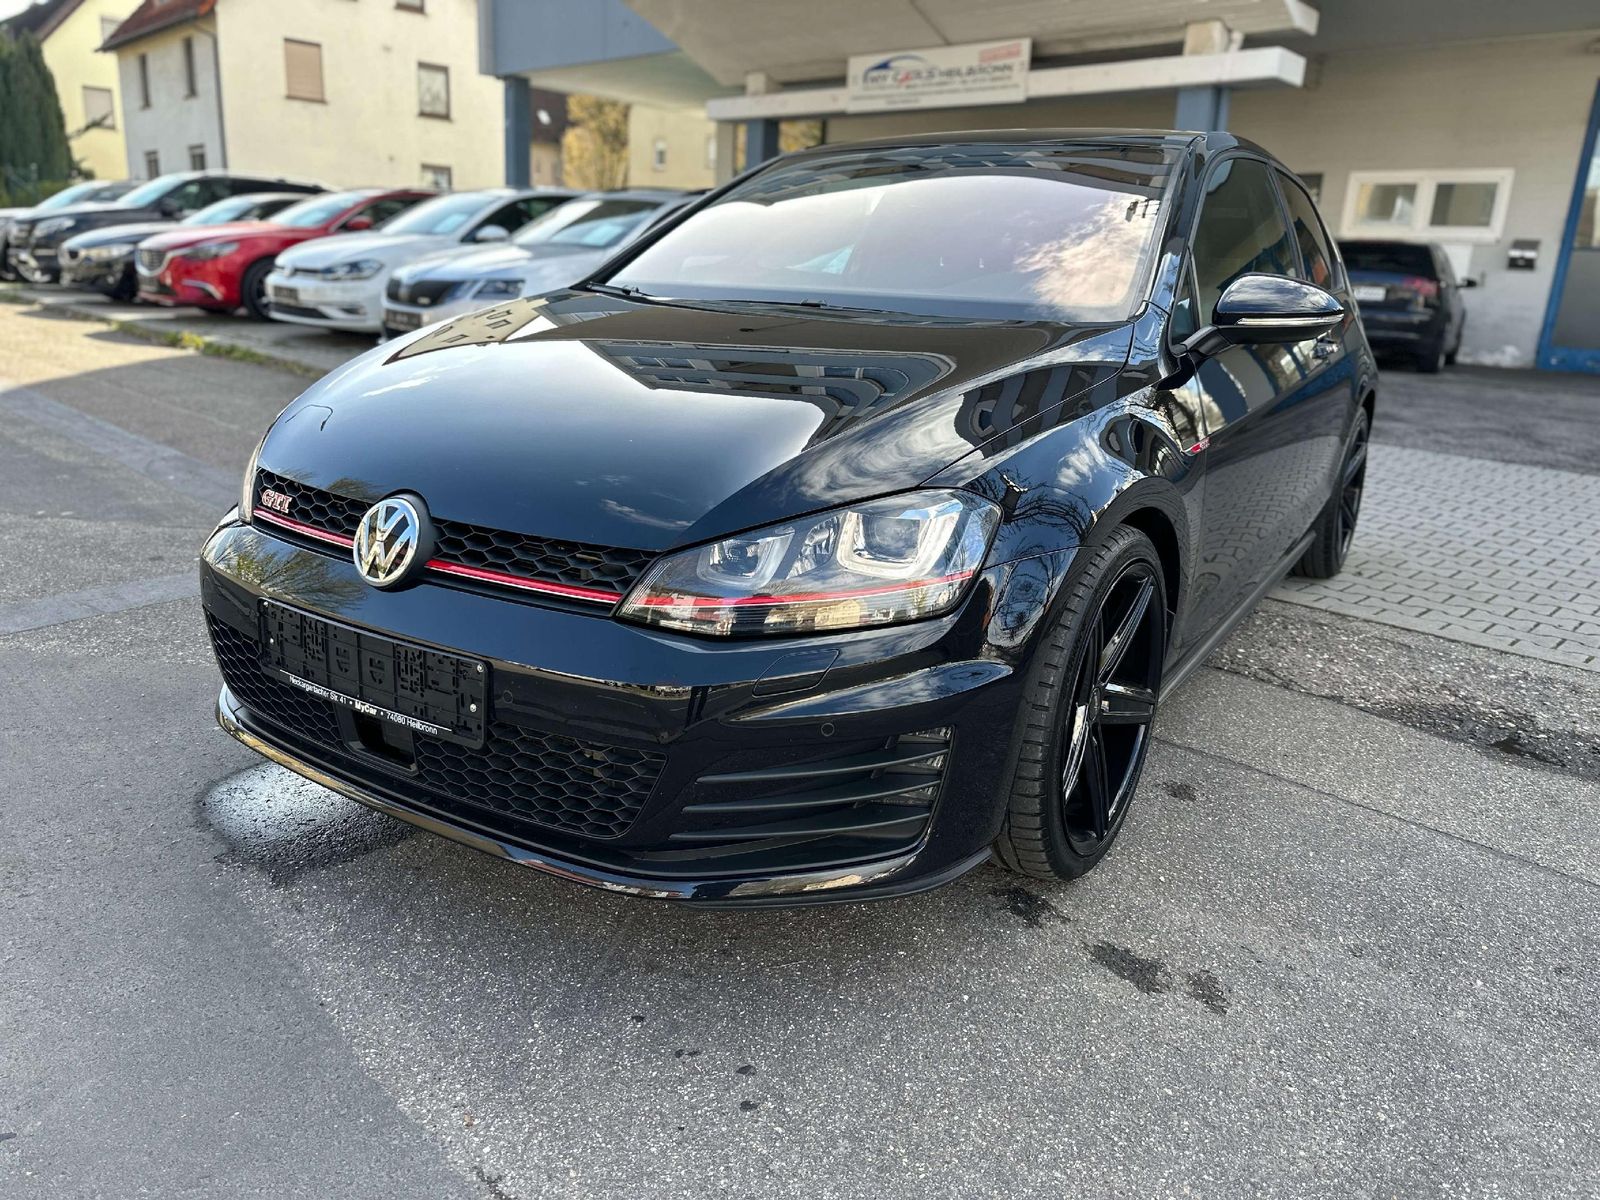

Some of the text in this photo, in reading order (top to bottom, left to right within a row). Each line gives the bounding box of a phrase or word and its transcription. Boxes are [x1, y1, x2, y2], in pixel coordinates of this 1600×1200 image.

[261, 489, 293, 514] GTI
[339, 696, 347, 704] 41
[354, 700, 378, 716] MyCar
[407, 718, 438, 736] Heilbronn
